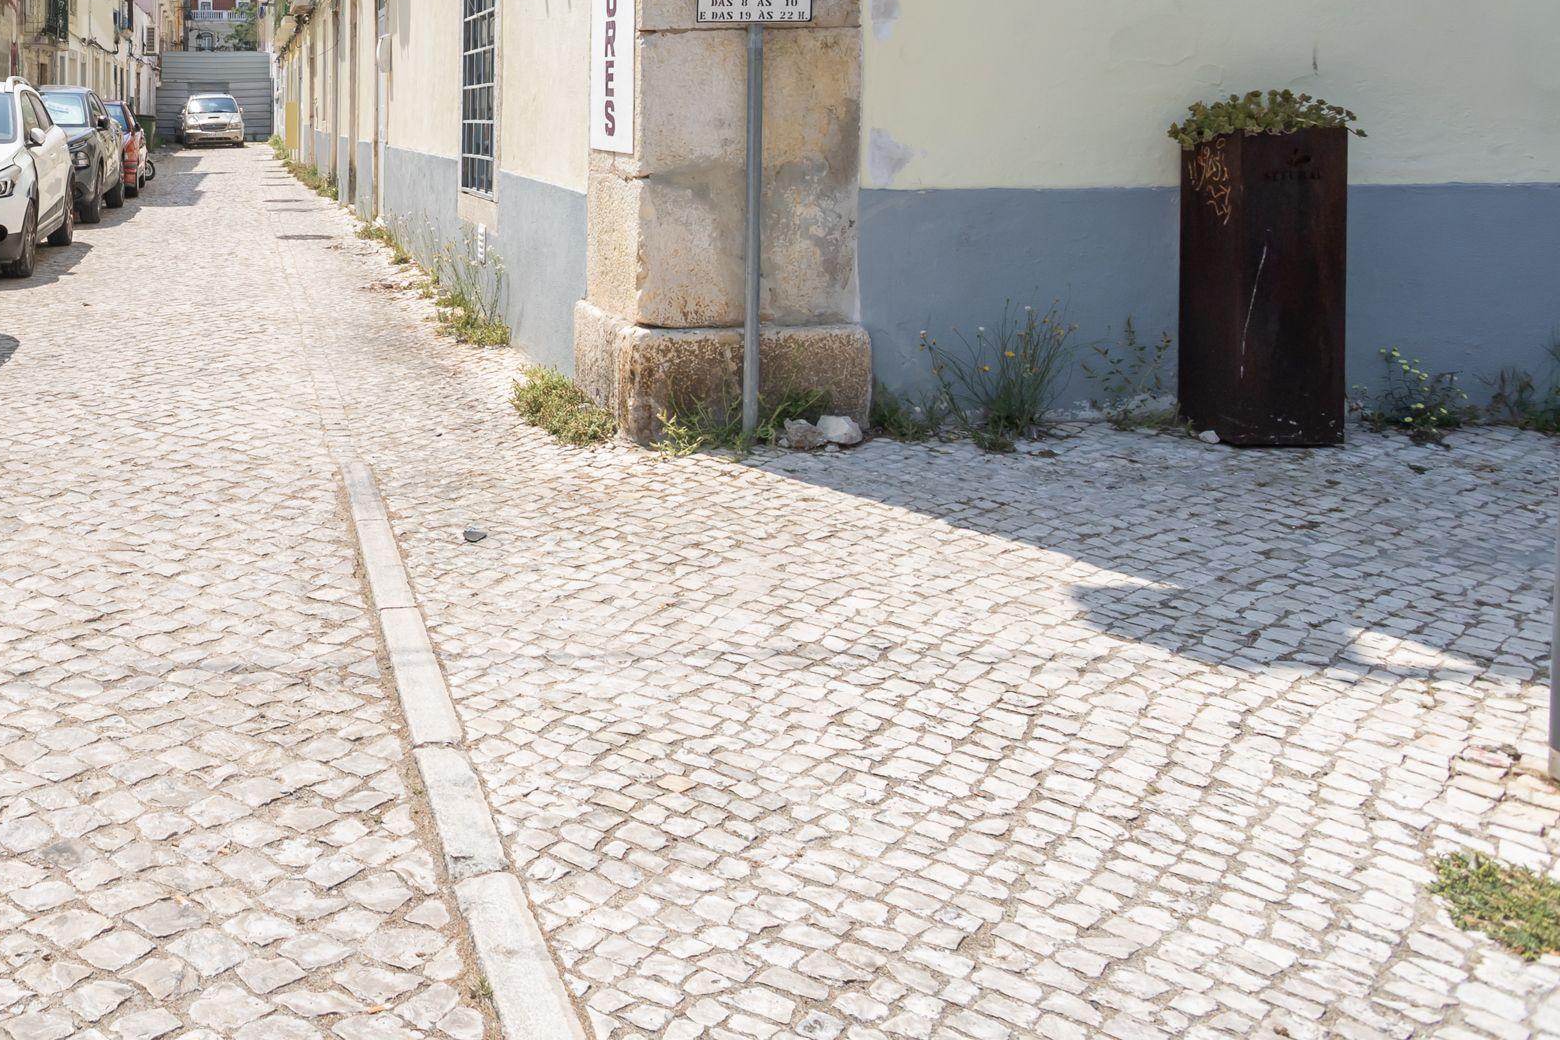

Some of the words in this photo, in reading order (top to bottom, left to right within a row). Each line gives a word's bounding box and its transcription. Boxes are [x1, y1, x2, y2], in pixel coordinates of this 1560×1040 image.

[741, 0, 748, 7] 8
[785, 0, 798, 7] 10
[700, 11, 706, 20] E
[711, 11, 733, 20] DAS
[740, 12, 751, 20] 19
[758, 10, 773, 20] ÀS
[780, 11, 793, 20] 22
